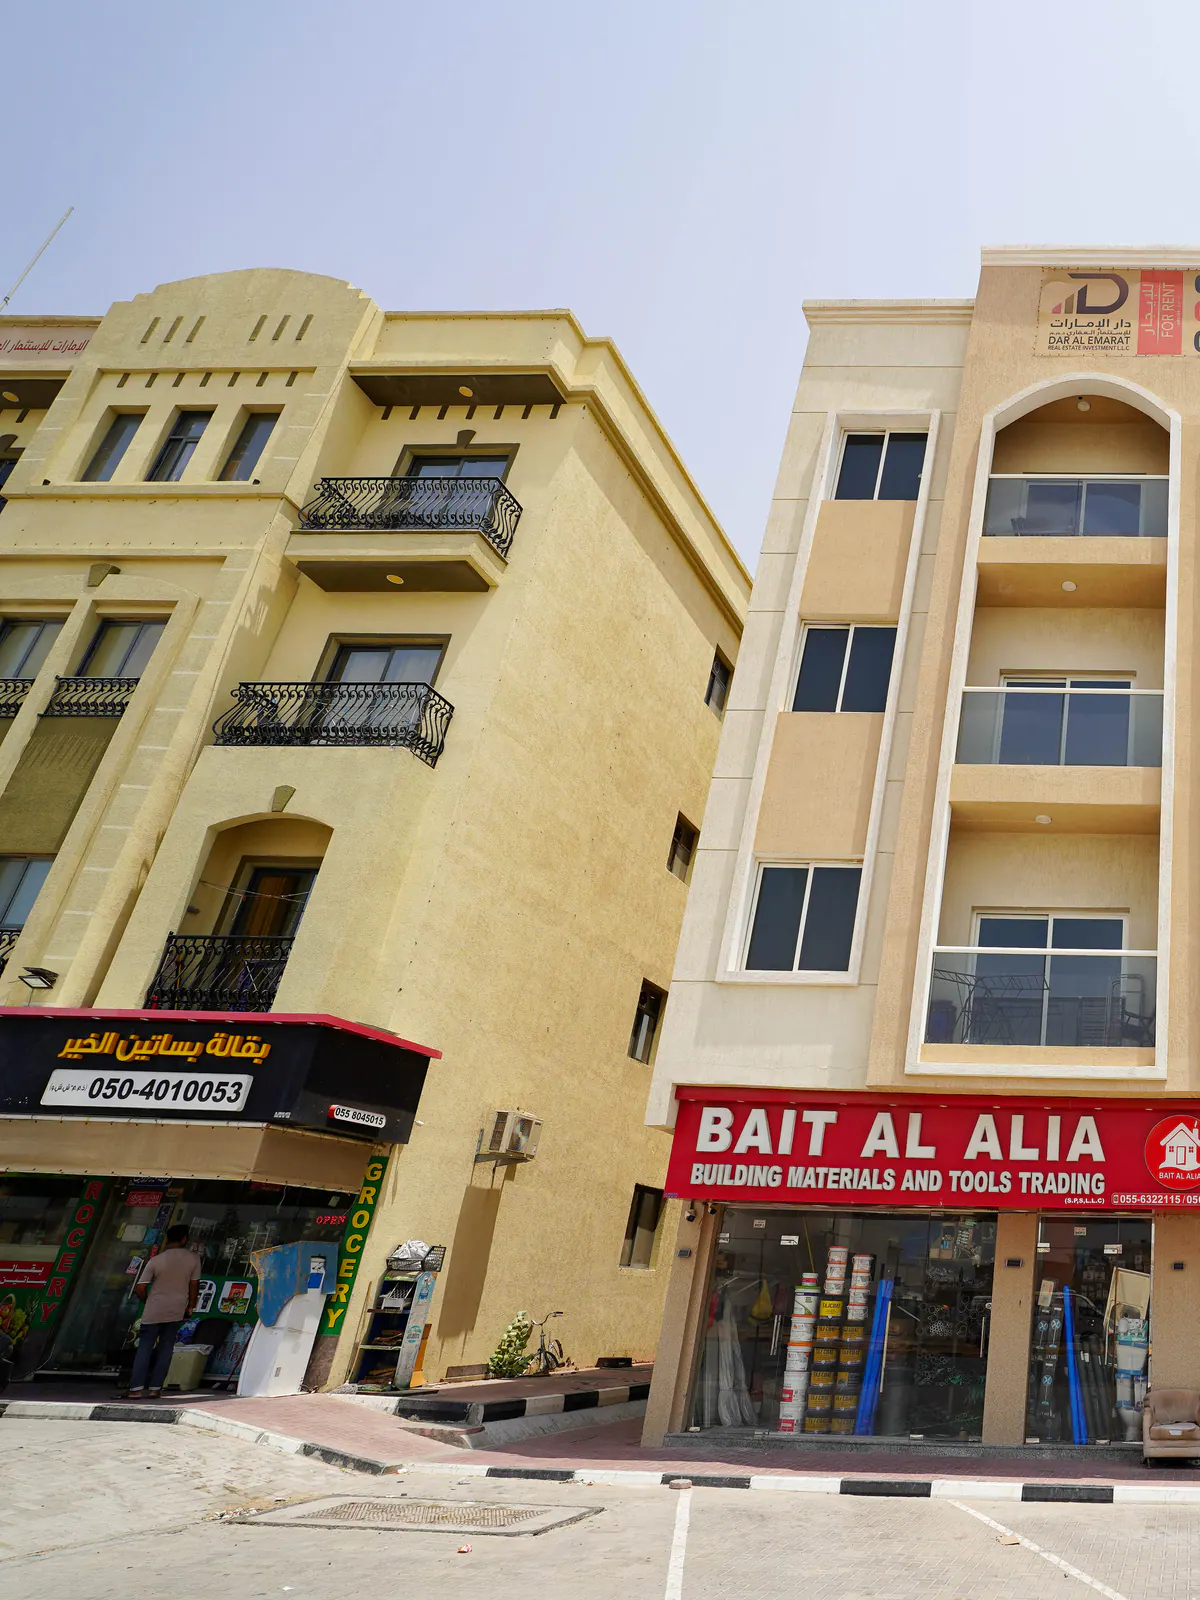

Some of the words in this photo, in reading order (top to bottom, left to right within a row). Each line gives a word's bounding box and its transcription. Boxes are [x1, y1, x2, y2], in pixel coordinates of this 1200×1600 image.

[1162, 282, 1175, 311] RENT
[1113, 319, 1131, 328] دار
[1162, 315, 1174, 338] FOR
[1048, 336, 1070, 344] DAR
[1072, 336, 1085, 344] AL
[1088, 336, 1131, 345] EMARAT
[57, 1031, 121, 1060] الخير
[116, 1033, 205, 1063] بساتين
[206, 1032, 271, 1065] بقالة
[88, 1077, 244, 1104] 050-4010053
[335, 1107, 349, 1118] 055
[351, 1111, 385, 1126] 8045015
[696, 1107, 838, 1157] BAIT
[860, 1111, 936, 1159] AL
[963, 1114, 1106, 1162] ALIA
[690, 1163, 783, 1187] BUILDING
[787, 1166, 896, 1190] MATERIALS
[900, 1169, 942, 1192] AND
[949, 1171, 1012, 1193] TOOLS
[1019, 1171, 1105, 1195] TRADING
[1120, 1194, 1181, 1204] 055-6322115
[315, 1215, 347, 1226] OPEN
[40, 1181, 103, 1322] ROCERY
[327, 1162, 383, 1328] GROCERY
